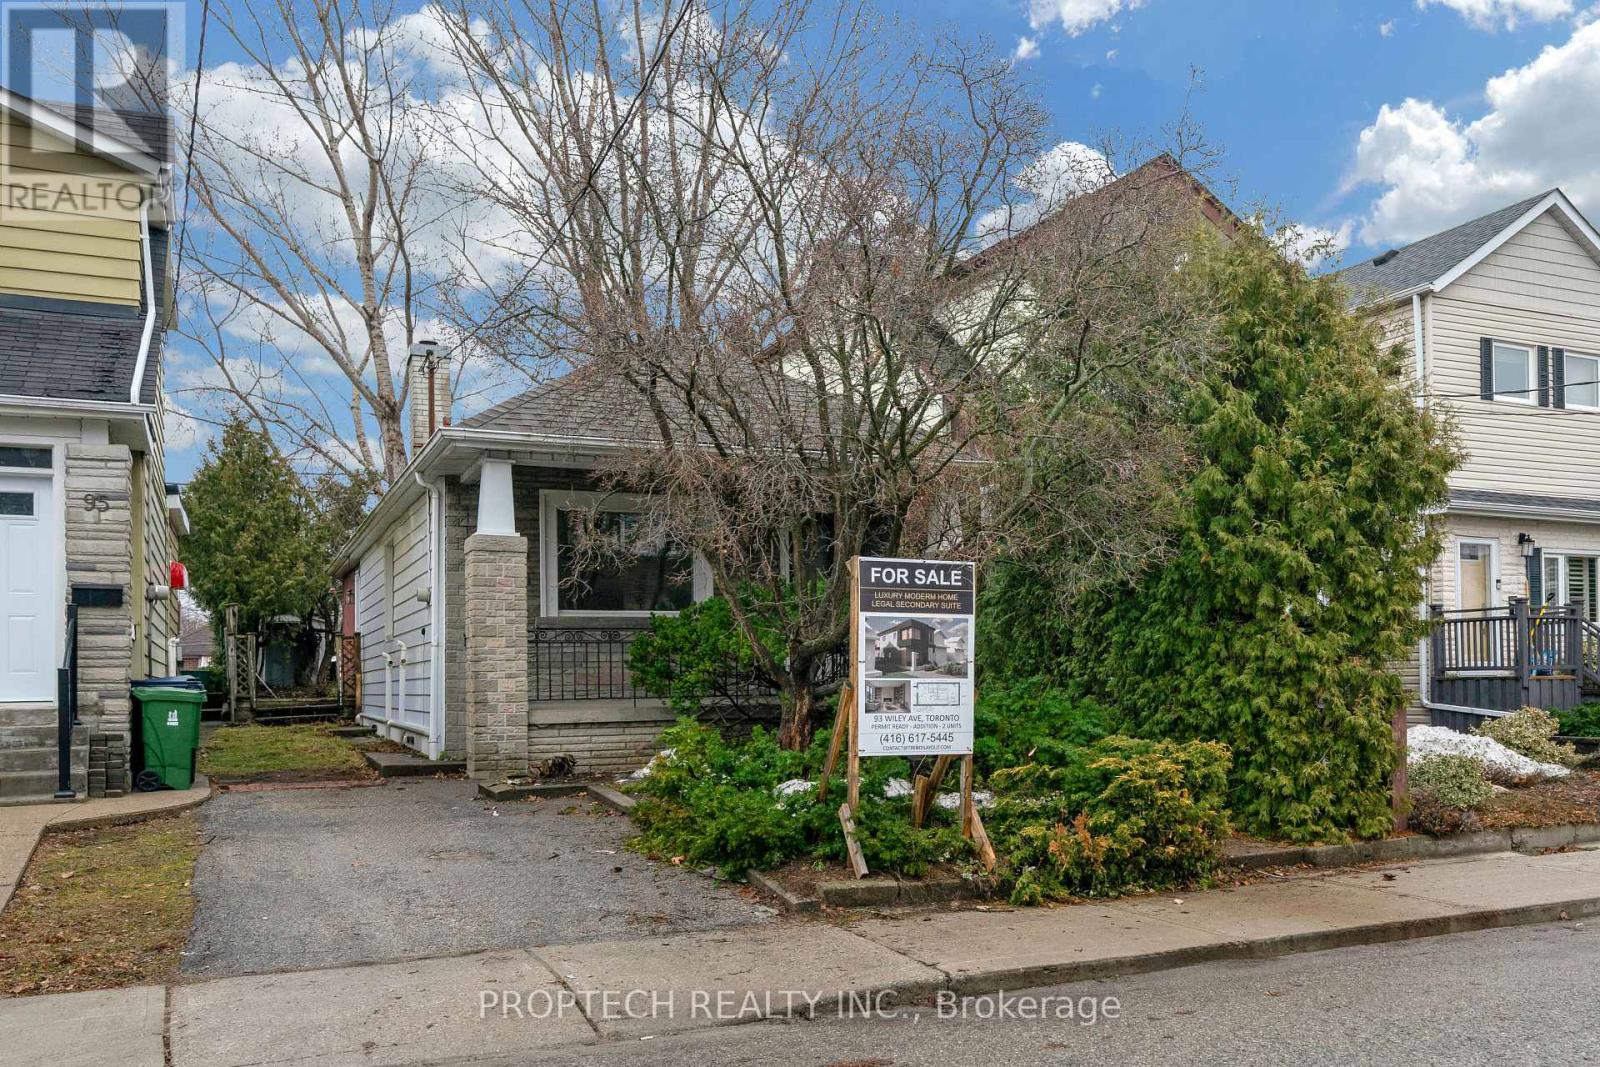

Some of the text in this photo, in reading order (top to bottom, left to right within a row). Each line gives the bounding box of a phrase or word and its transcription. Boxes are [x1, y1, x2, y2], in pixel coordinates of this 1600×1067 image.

[84, 493, 110, 512] 95
[871, 567, 963, 586] FOR SALE
[874, 591, 903, 600] LUXURY
[937, 593, 959, 601] HOME
[871, 600, 961, 610] LEGAL SECONDARY SUITE
[873, 714, 960, 723] 93 WILEY AVE, TORONTO
[879, 732, 954, 745] (416) 617-5445
